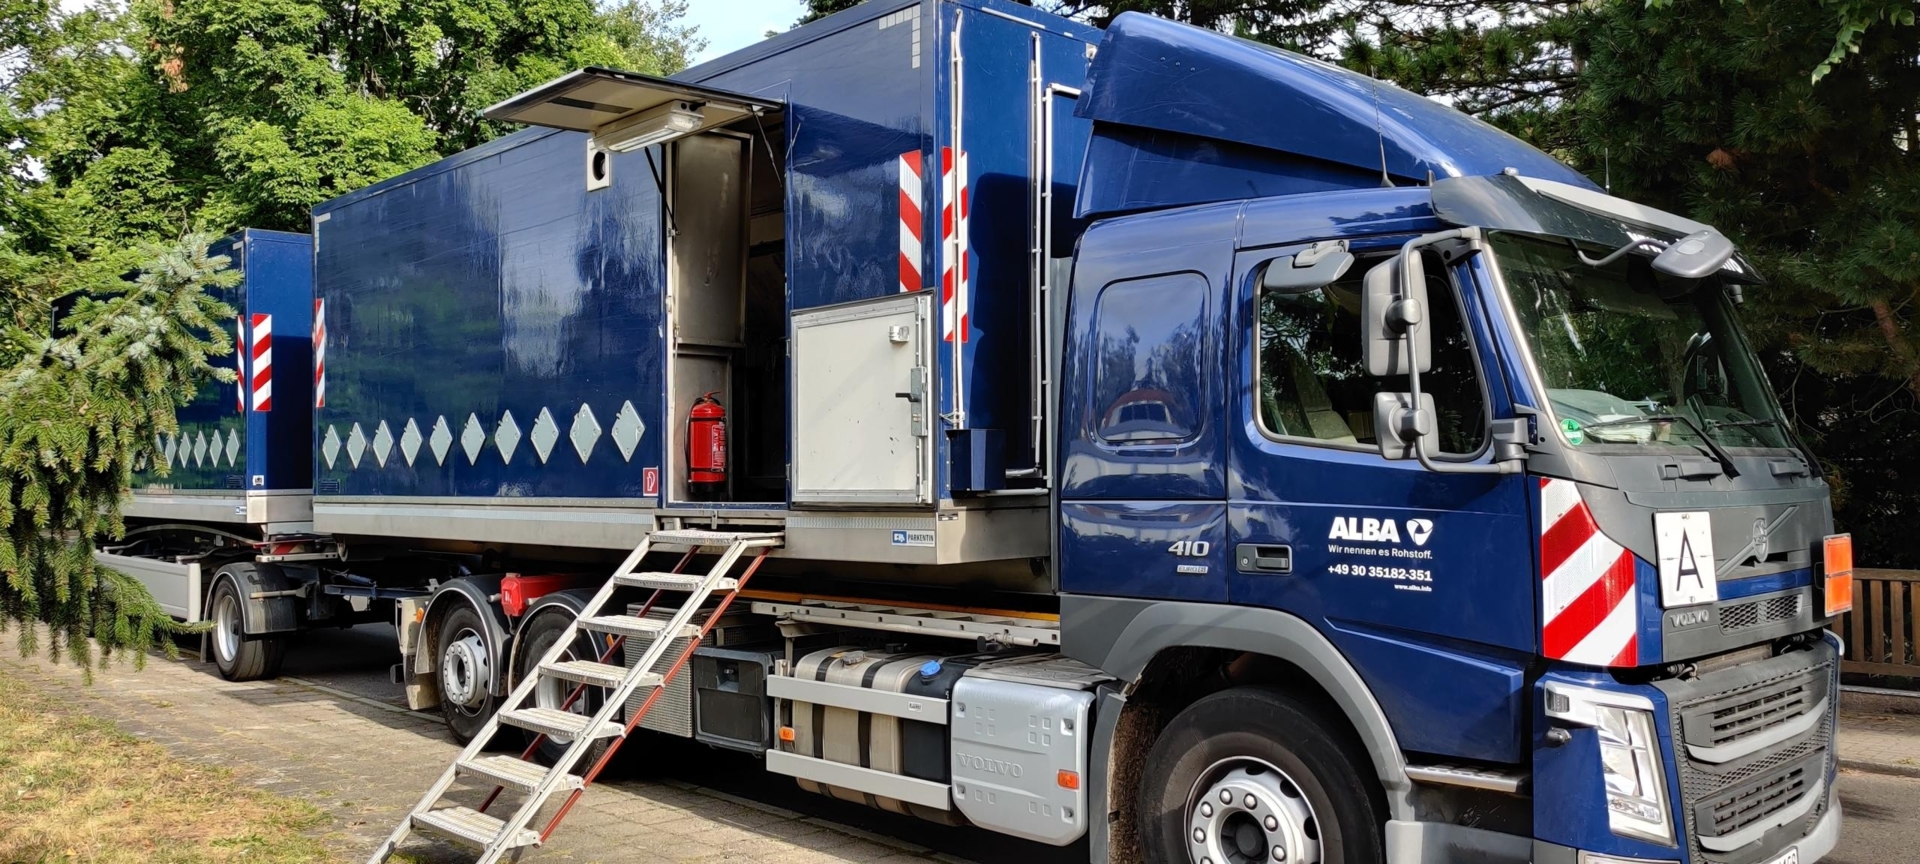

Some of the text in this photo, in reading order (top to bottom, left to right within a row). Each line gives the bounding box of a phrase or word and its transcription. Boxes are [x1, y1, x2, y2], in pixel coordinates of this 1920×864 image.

[1567, 420, 1575, 431] 4
[907, 533, 934, 542] PARKENTIN
[1328, 516, 1401, 543] ALBA
[1168, 540, 1210, 556] 410
[1328, 544, 1433, 560] Wir nennen es Rohstoff.
[1676, 527, 1704, 591] A
[1328, 564, 1433, 581] +49 30 35182-351
[1670, 609, 1709, 627] VOLVO
[957, 752, 1024, 778] VOLVO
